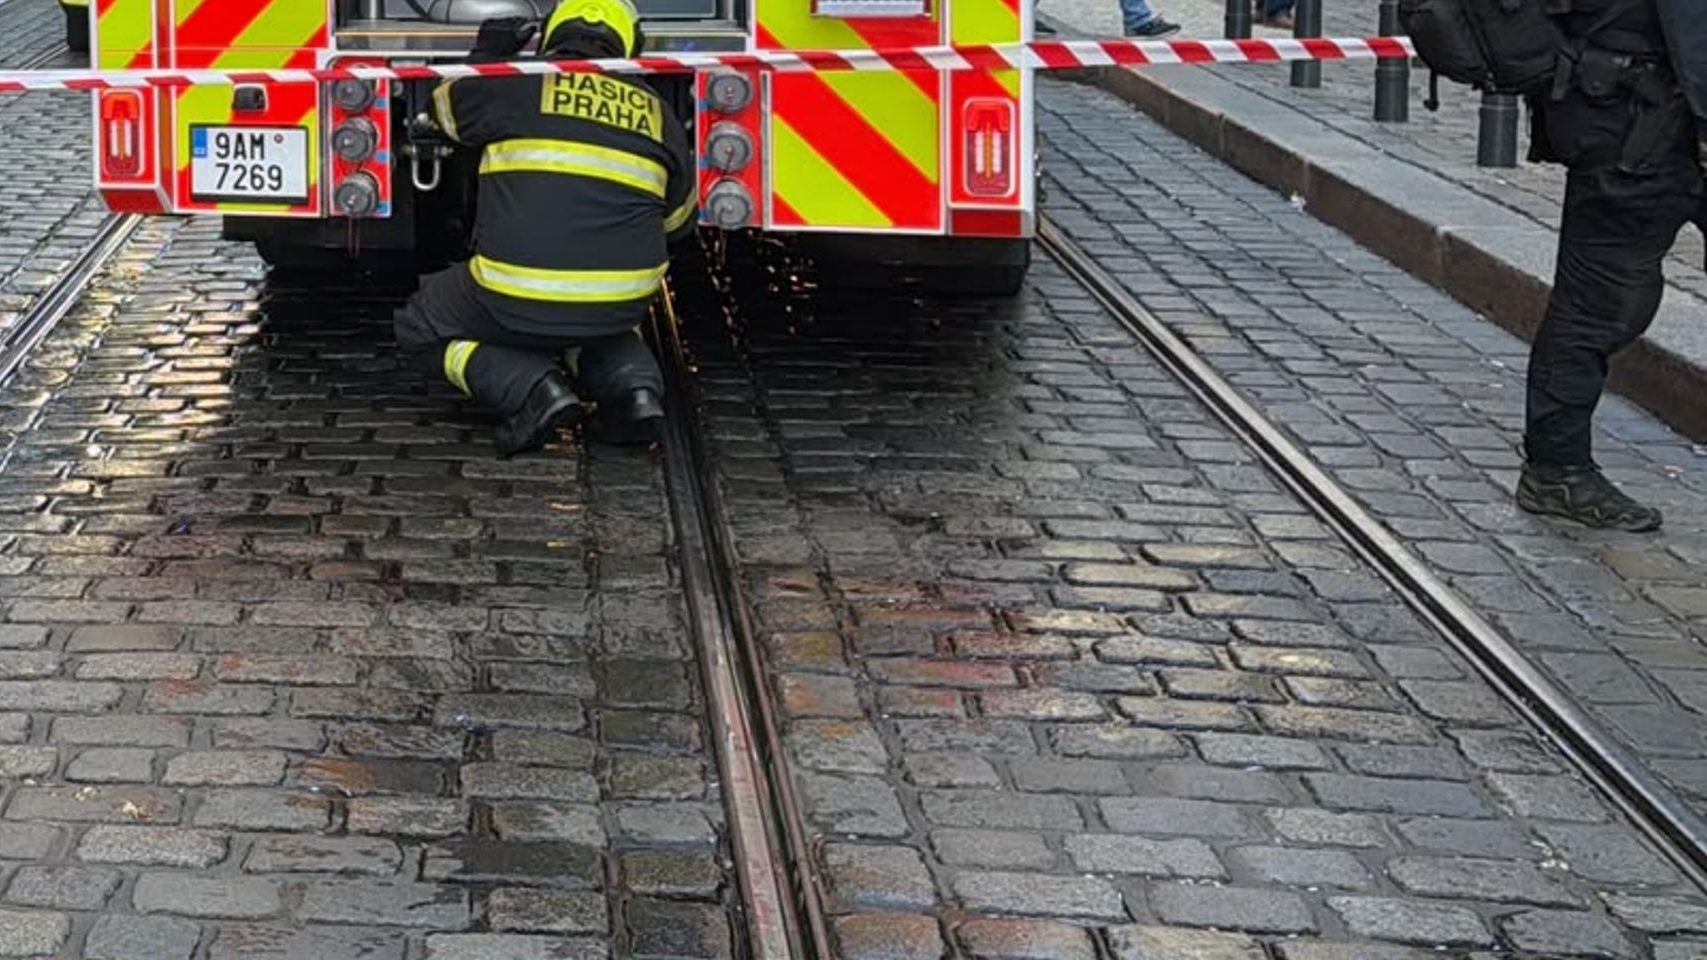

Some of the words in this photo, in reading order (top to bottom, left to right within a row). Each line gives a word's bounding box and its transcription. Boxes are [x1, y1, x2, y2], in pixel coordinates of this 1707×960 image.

[553, 90, 654, 137] PRAHA
[215, 131, 266, 160] 9AM
[215, 162, 284, 192] 7269
